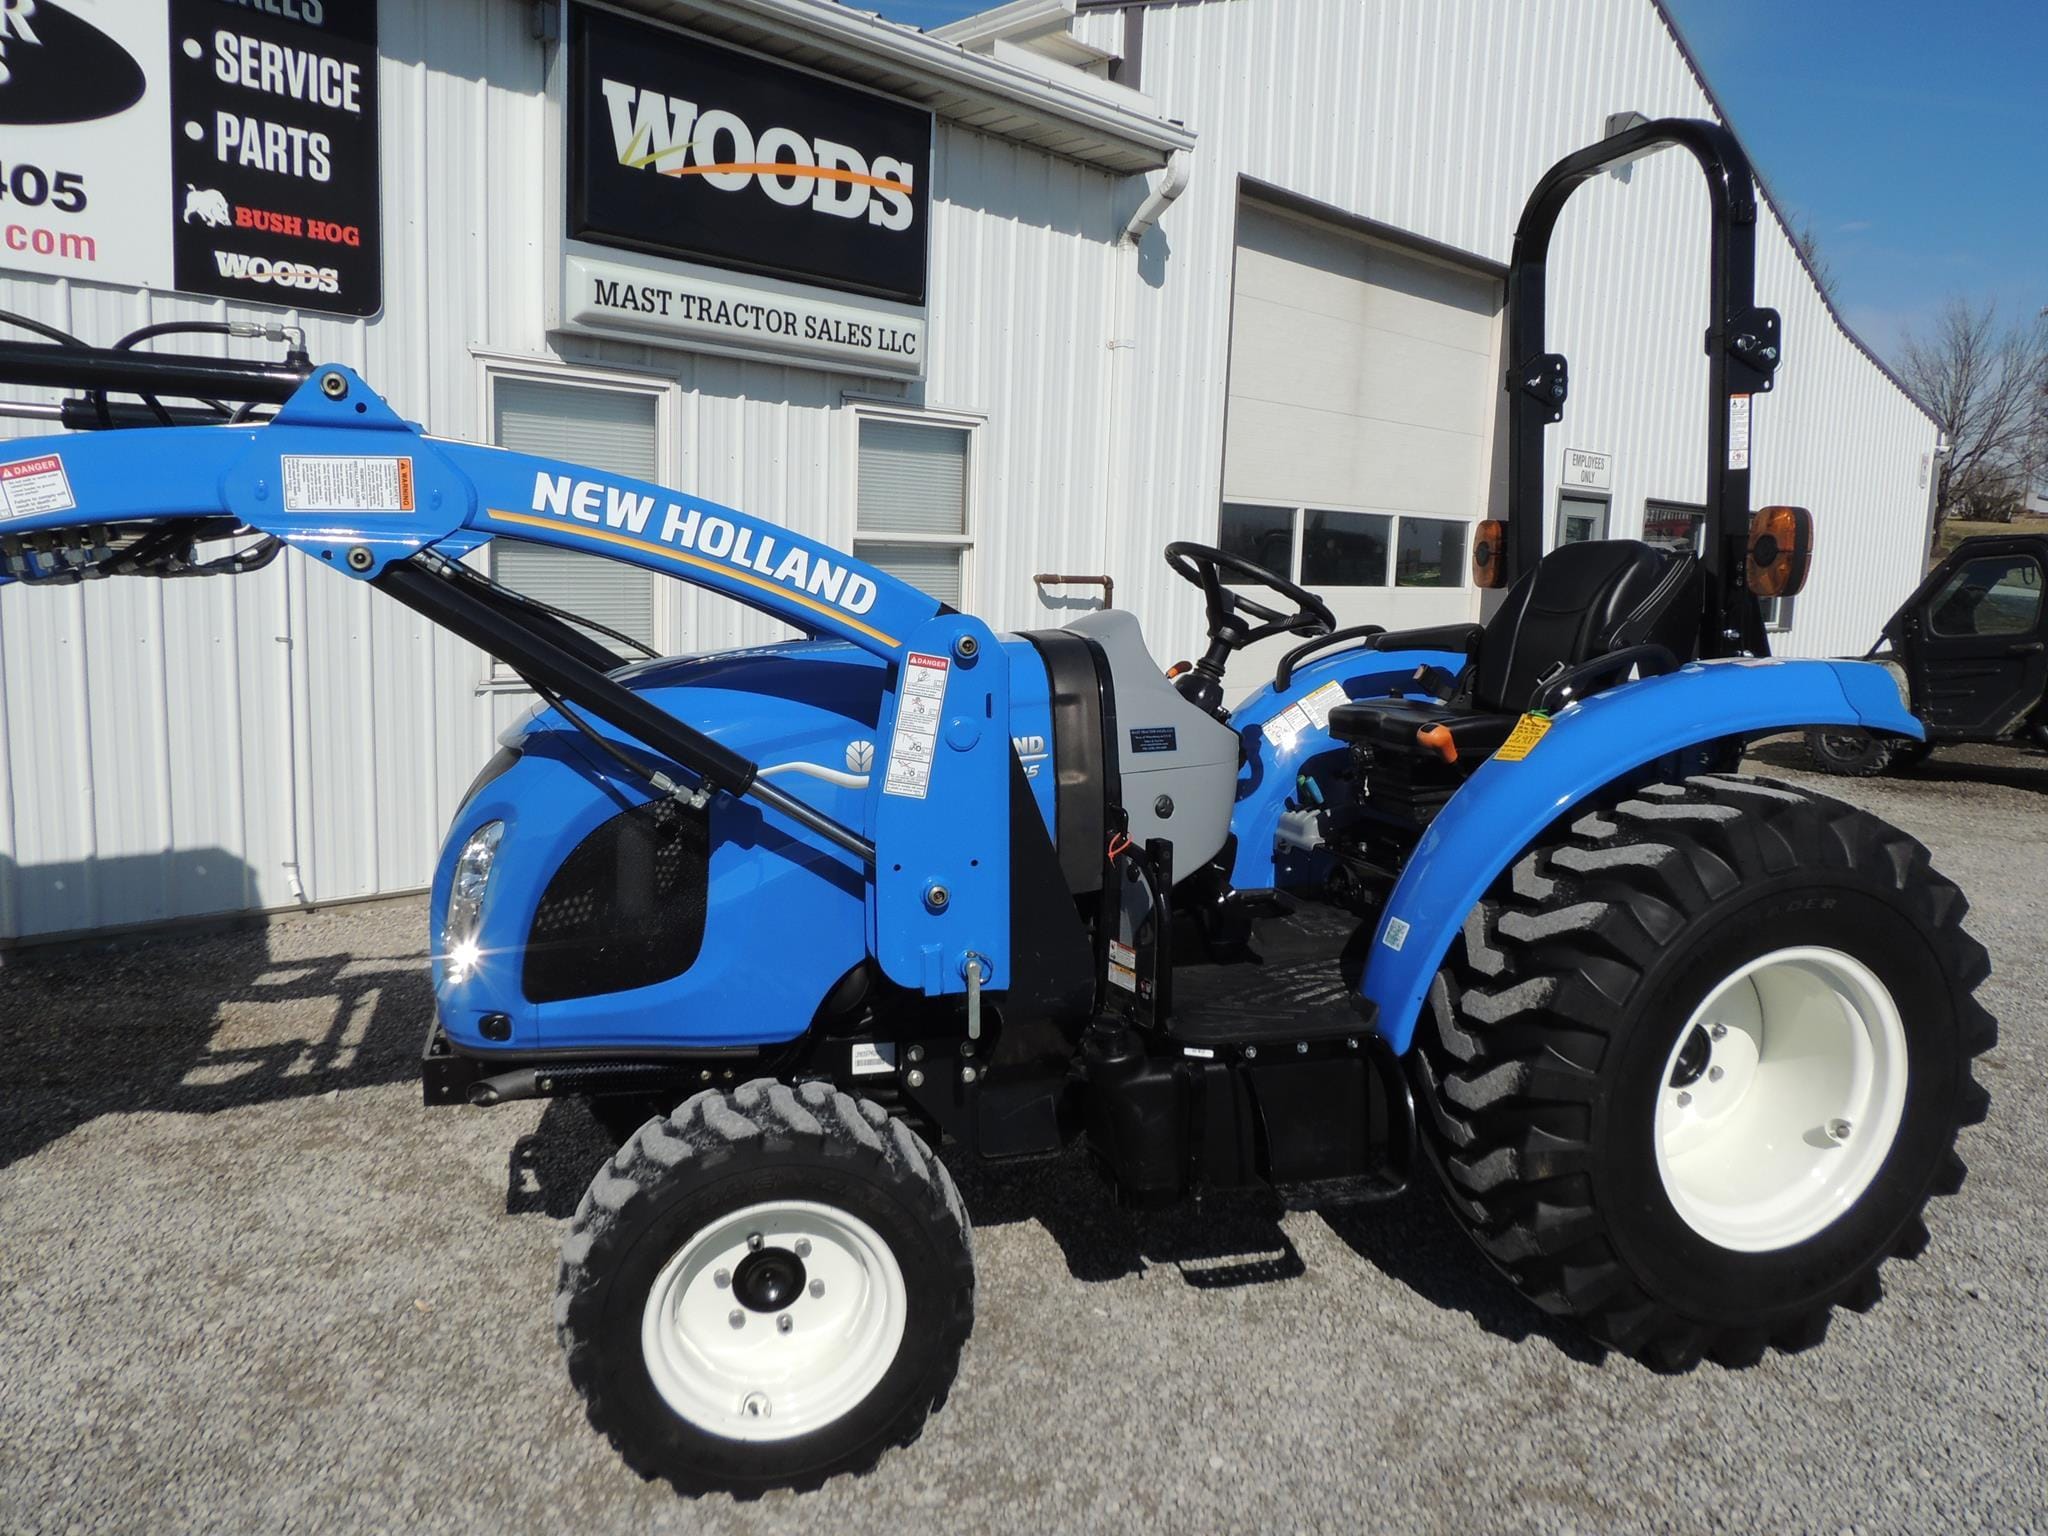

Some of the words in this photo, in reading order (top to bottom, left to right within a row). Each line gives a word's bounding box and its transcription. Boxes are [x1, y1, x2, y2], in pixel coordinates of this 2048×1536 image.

[215, 30, 361, 113] SERVICE
[216, 111, 331, 182] PARTS
[602, 78, 914, 231] WOODS
[235, 206, 302, 237] BUSH
[307, 219, 360, 247] HOG
[214, 250, 339, 293] WOODS
[594, 278, 672, 315] MAST
[680, 293, 799, 337] TRACTOR
[804, 315, 873, 348] SALES
[878, 328, 916, 355] LLC
[13, 460, 56, 475] DANGER
[1572, 453, 1605, 470] EMPLOYEES
[402, 473, 410, 506] WARNING
[531, 471, 656, 534] NEW
[660, 503, 878, 615] HOLLAND
[917, 657, 946, 669] DANGER
